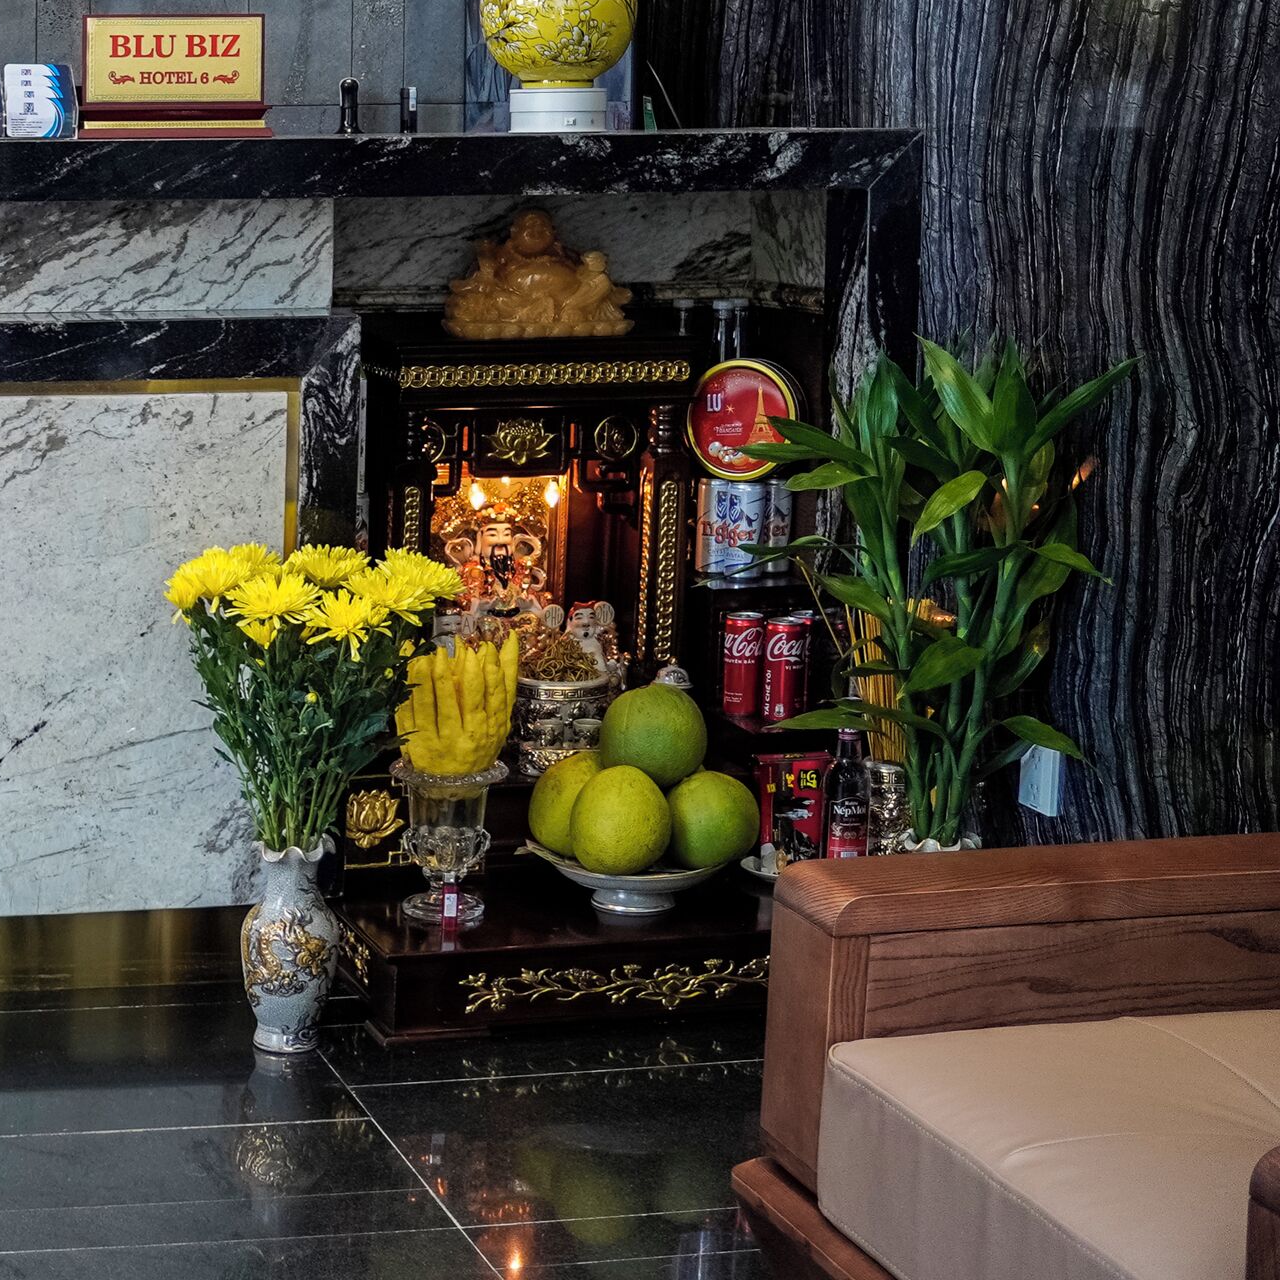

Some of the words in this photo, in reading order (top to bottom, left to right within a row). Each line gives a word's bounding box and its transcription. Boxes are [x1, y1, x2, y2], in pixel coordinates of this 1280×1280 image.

[109, 34, 177, 58] BLU
[185, 34, 241, 58] BIZ
[139, 71, 197, 85] HOTEL
[200, 71, 210, 85] 6
[706, 393, 722, 412] LU
